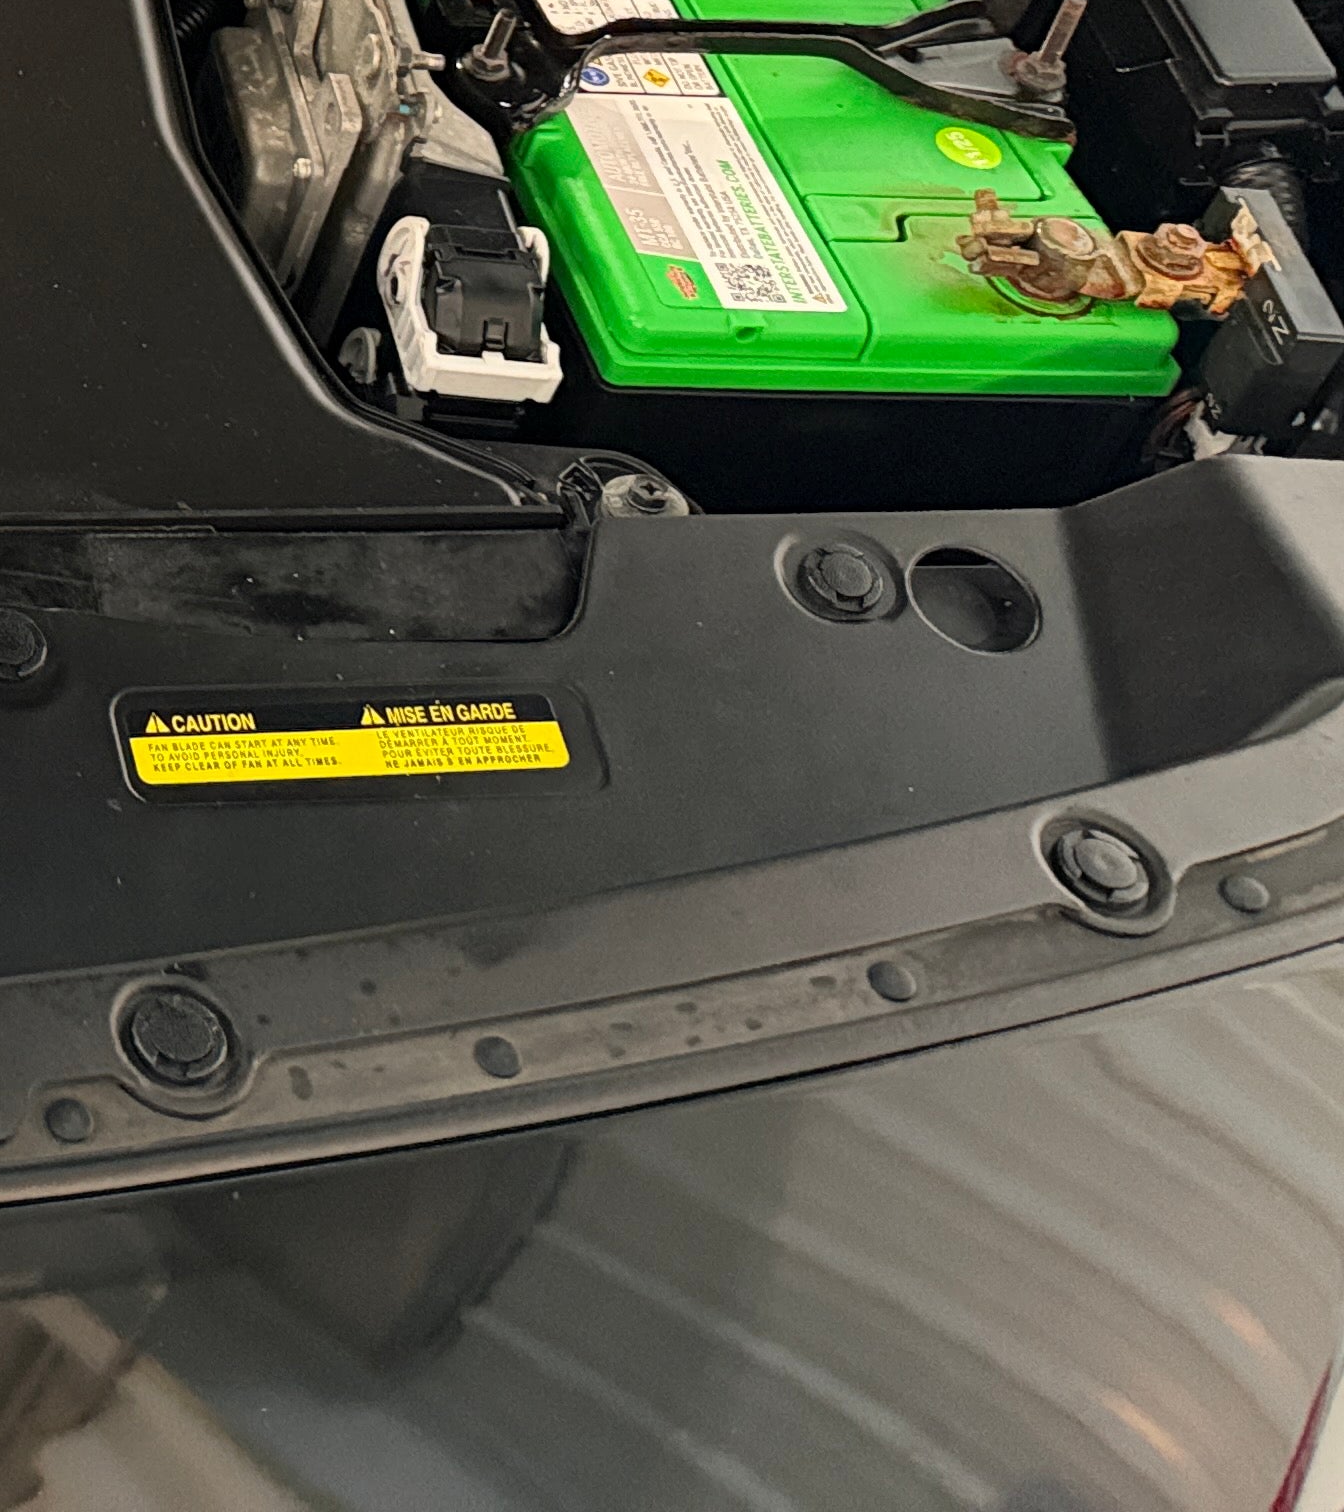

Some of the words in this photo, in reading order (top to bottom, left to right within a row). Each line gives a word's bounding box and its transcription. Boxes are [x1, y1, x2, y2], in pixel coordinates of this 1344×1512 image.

[714, 159, 807, 303] INTERSTATEBATTERIES.COM
[385, 705, 428, 725] MISE
[429, 704, 455, 723] EN
[456, 702, 517, 722] GARDE
[171, 712, 257, 733] CAUTION
[376, 730, 390, 740] LE
[394, 727, 465, 739] VENTILATEUR
[469, 725, 508, 736] RISQUE
[512, 725, 525, 734] DE
[148, 742, 168, 752] FAN
[172, 741, 205, 752] BLADE
[209, 740, 231, 750] CAN
[235, 739, 267, 749] START
[271, 738, 283, 748] AT
[286, 737, 307, 747] ANY
[382, 749, 412, 759] POUR
[457, 745, 490, 756] TOUTE
[151, 753, 165, 762] TO
[168, 751, 200, 762] AVOID
[204, 749, 259, 761] PERSONAL
[153, 762, 181, 772] KEEP
[185, 760, 220, 771] CLEAR
[224, 760, 237, 770] OF
[242, 759, 262, 769] FAN
[266, 758, 279, 768] AT
[282, 757, 303, 767] ALL
[385, 760, 399, 769] NE
[403, 758, 443, 768] JAMAIS
